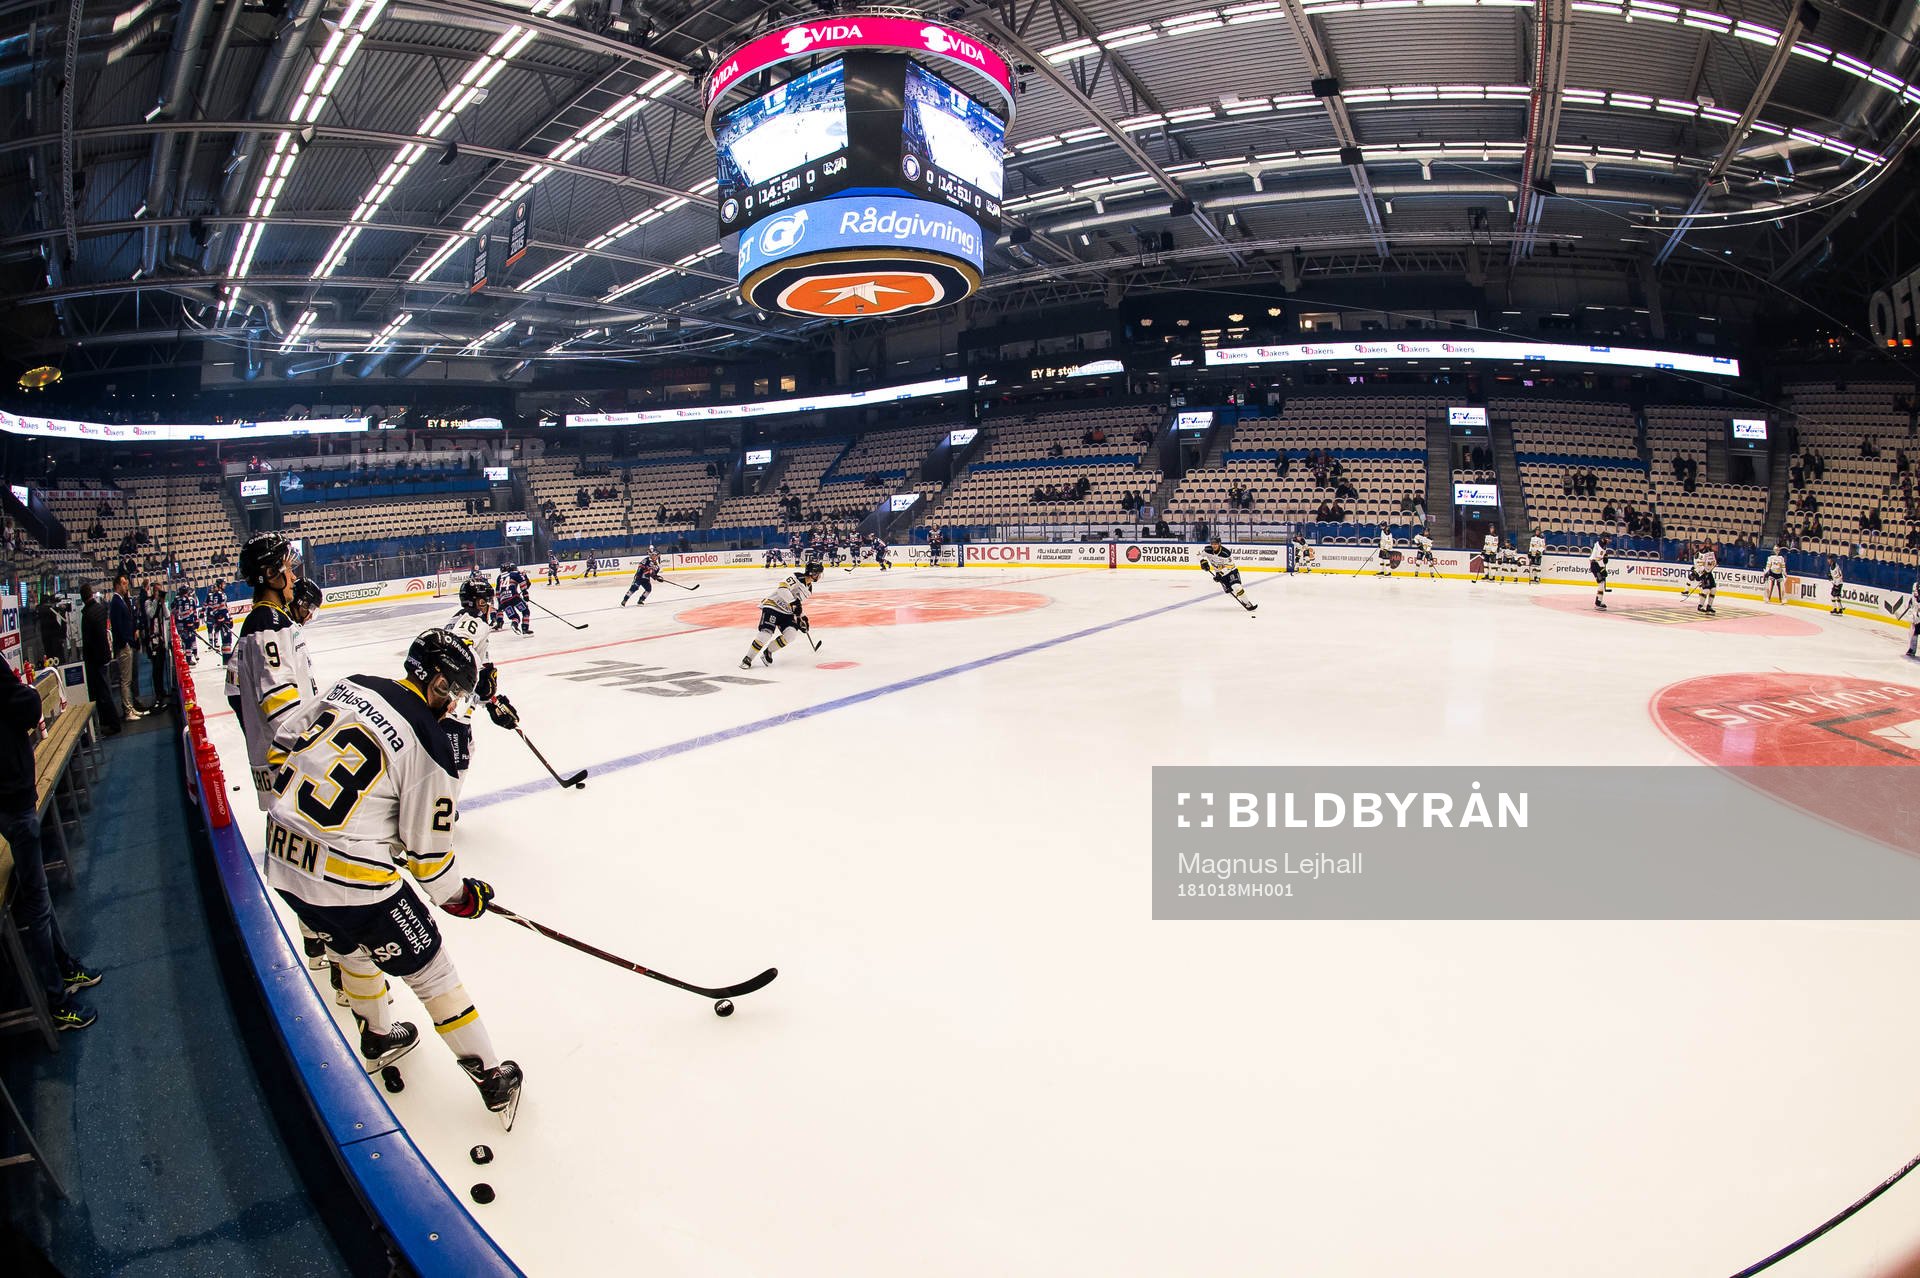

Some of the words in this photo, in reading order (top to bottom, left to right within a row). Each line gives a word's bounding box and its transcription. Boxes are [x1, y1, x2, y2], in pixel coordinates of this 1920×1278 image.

[810, 25, 863, 42] VIDA
[946, 39, 986, 65] VIDA
[714, 60, 739, 89] VIDA
[806, 169, 815, 184] 0
[926, 169, 934, 184] 0
[761, 176, 798, 204] 14:50
[940, 176, 969, 203] 14:51
[745, 195, 753, 210] 0
[975, 194, 982, 209] 0
[840, 206, 974, 256] Rådgivning
[1031, 369, 1044, 379] EY
[1046, 367, 1056, 378] är
[427, 419, 439, 428] EY
[966, 546, 1031, 561] RICOH
[1142, 546, 1190, 555] SYDTRADE
[678, 553, 719, 565] Templeo
[1142, 555, 1177, 563] TRUCKAR
[785, 576, 797, 587] 67
[325, 584, 382, 603] CASHBUDDY
[1858, 591, 1879, 605] DÄCK
[458, 619, 479, 635] 16
[265, 641, 281, 668] 9
[414, 666, 428, 681] 23
[1690, 684, 1914, 728] BAUHAUS
[340, 686, 405, 754] Husqvarna
[270, 708, 388, 833] 23
[397, 897, 434, 949] WILLIAMS
[390, 907, 425, 956] SHERWIN
